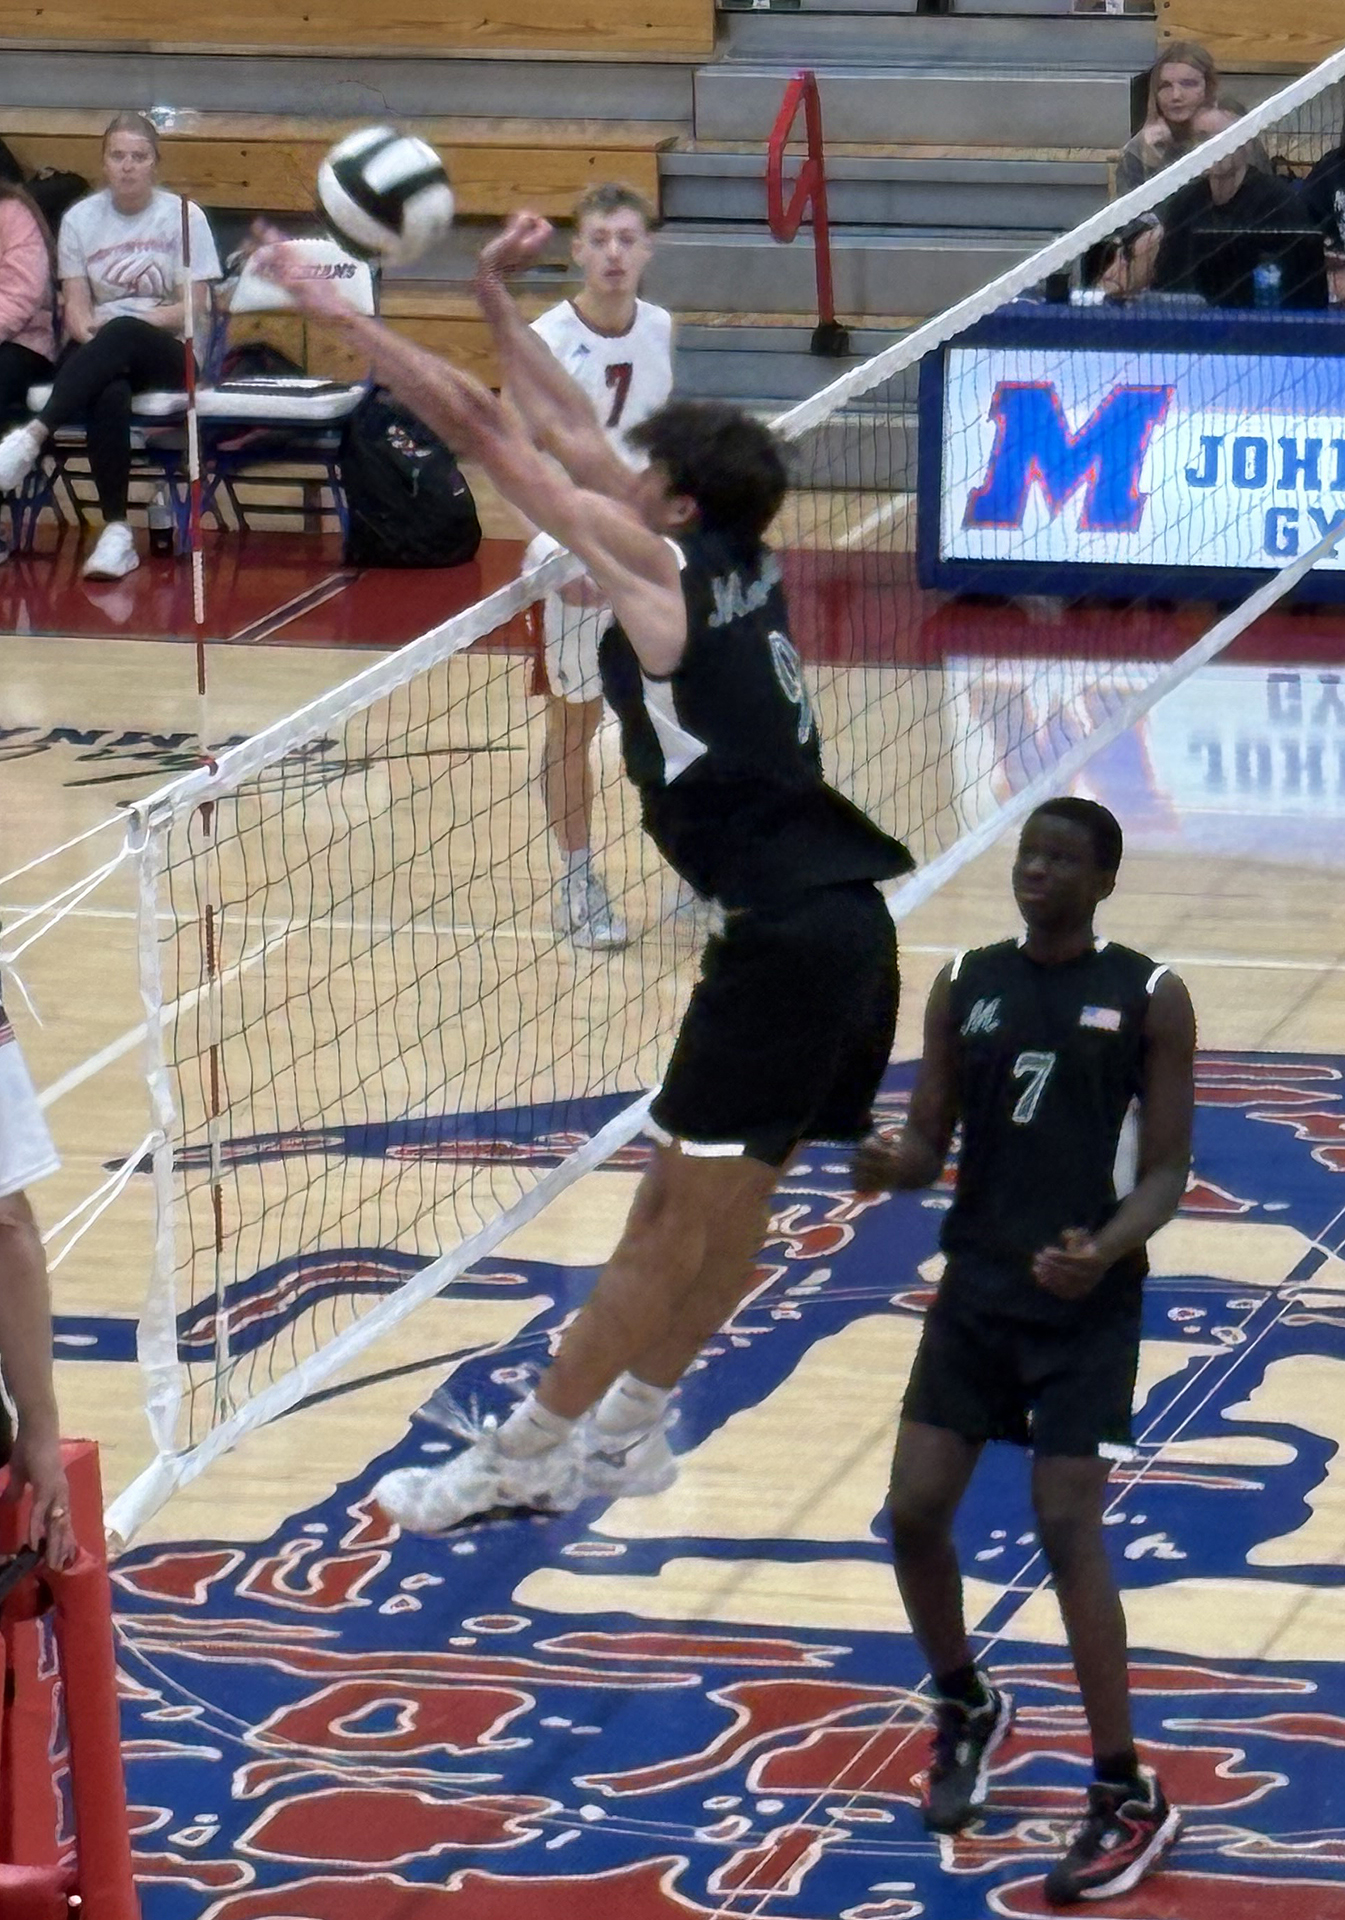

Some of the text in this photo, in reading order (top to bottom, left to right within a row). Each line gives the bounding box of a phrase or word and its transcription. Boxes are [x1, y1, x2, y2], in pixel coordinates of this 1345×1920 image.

[604, 362, 633, 428] 7
[962, 381, 1177, 533] M
[1012, 1052, 1056, 1123] 7
